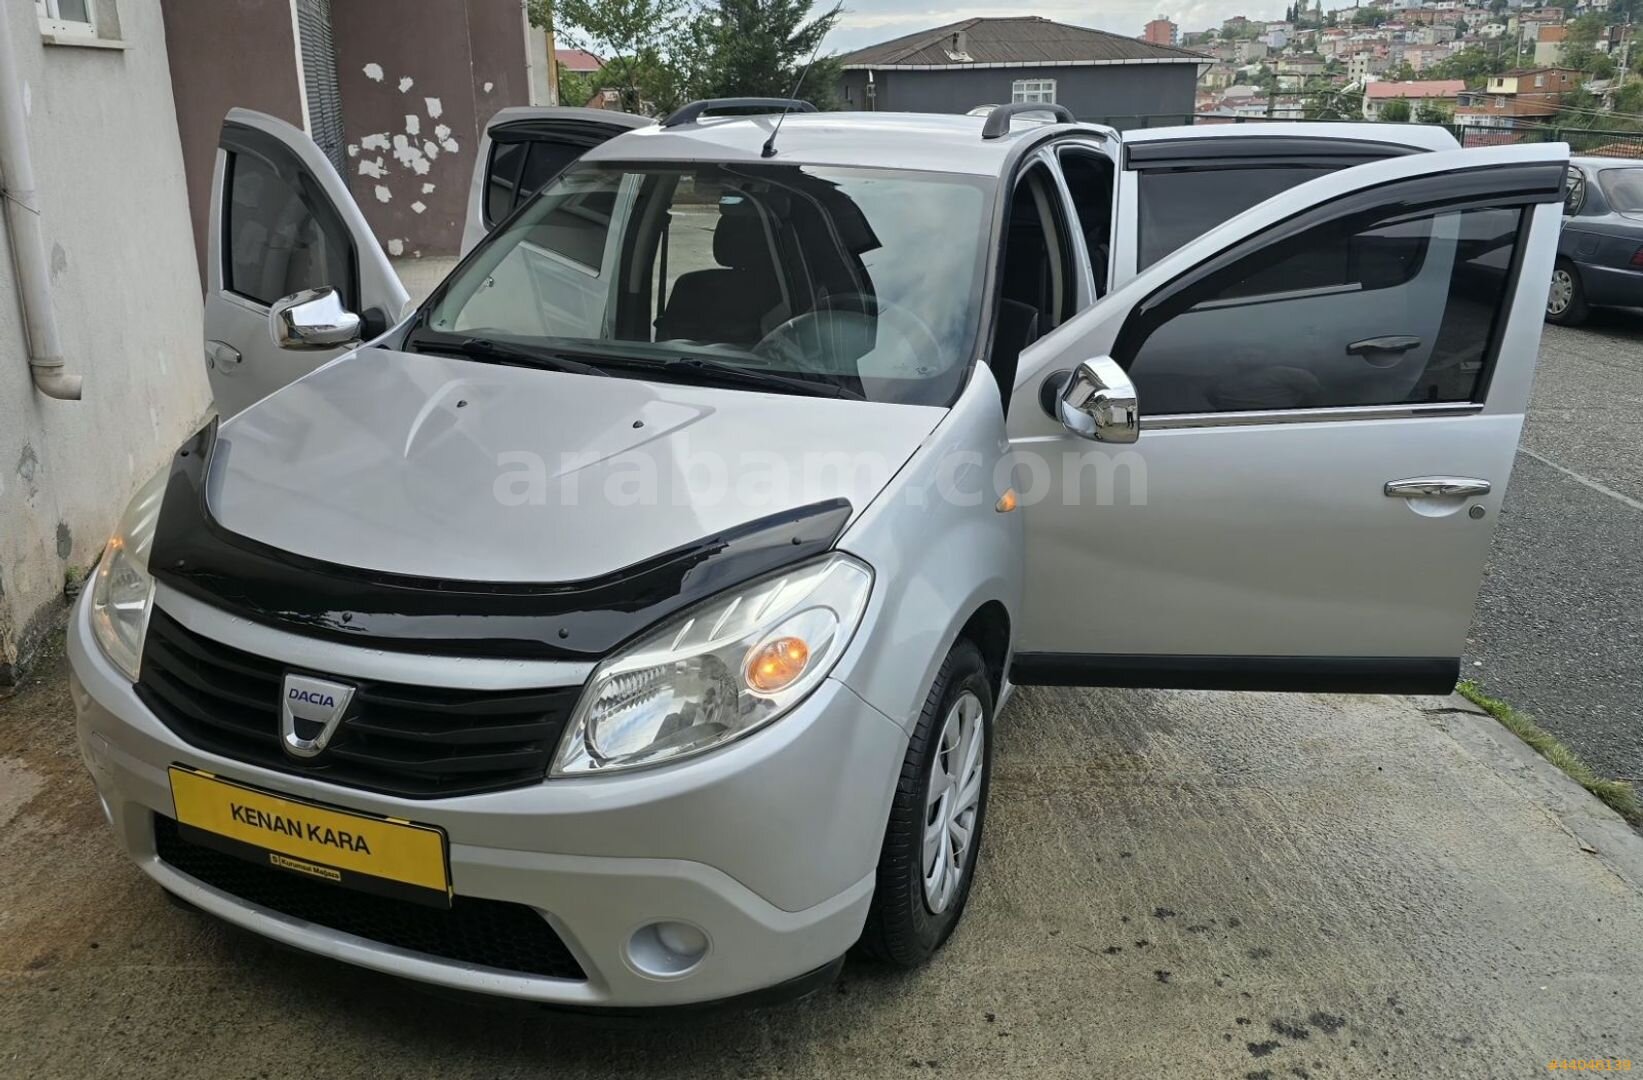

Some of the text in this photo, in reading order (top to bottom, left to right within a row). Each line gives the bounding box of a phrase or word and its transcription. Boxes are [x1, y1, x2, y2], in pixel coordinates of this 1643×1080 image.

[289, 688, 335, 708] DACIA
[231, 803, 371, 855] KENAN KARA
